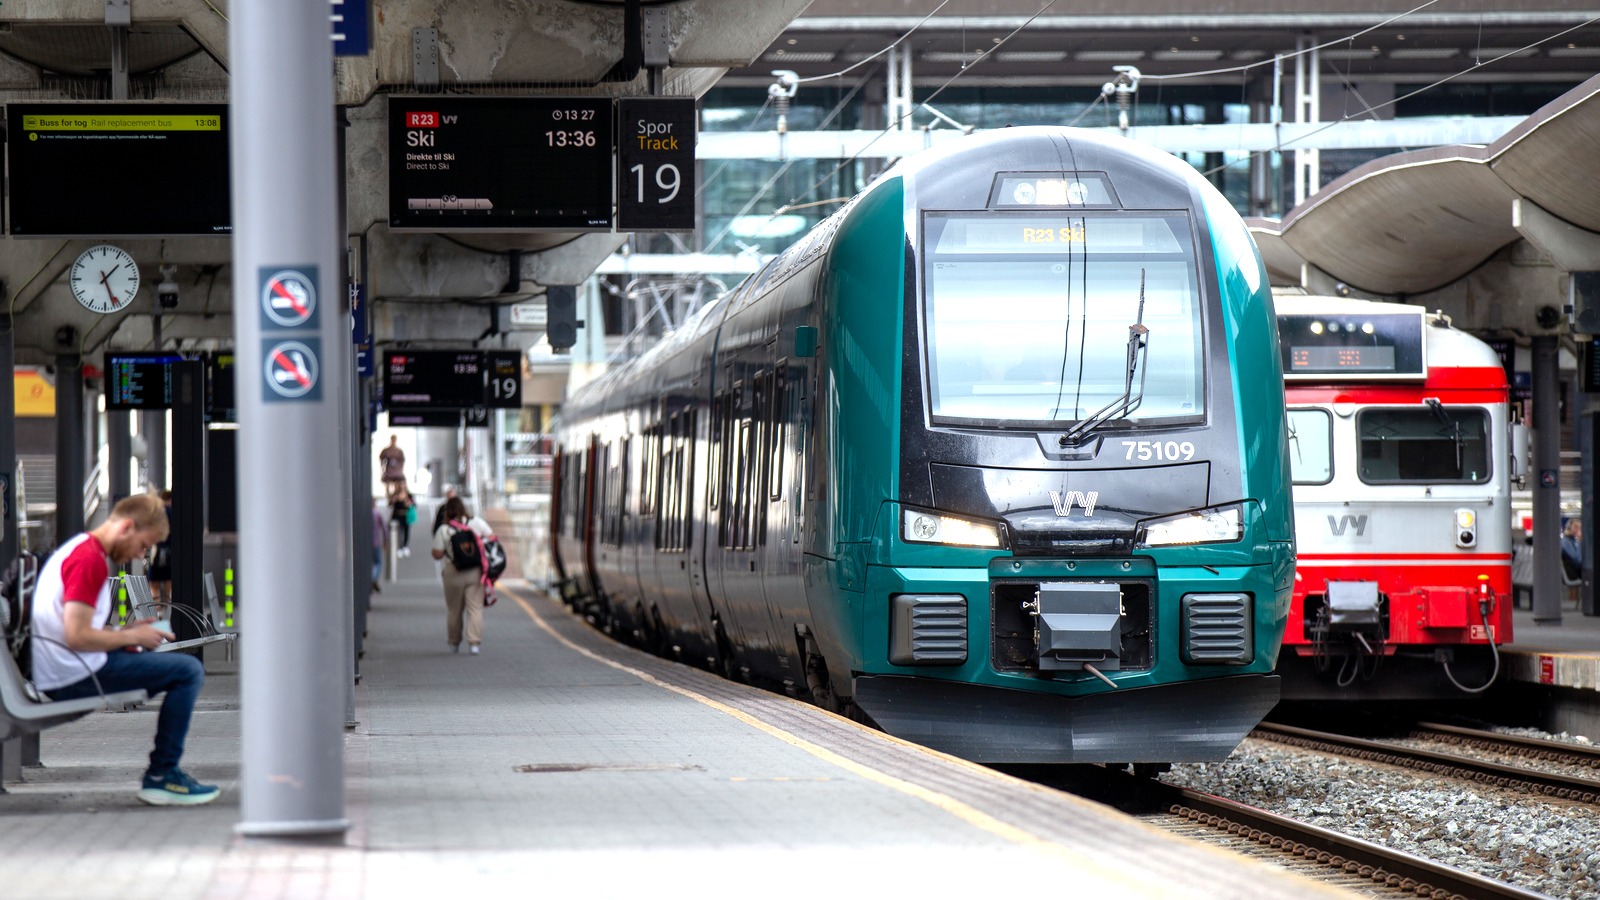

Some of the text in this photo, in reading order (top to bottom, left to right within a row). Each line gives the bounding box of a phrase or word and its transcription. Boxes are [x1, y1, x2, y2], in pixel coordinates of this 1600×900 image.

[40, 119, 217, 129] Buss for tog Rail replacement bus 13:08
[637, 119, 674, 138] Spor
[406, 130, 596, 147] Ski 13:36
[637, 135, 679, 151] Track
[406, 153, 455, 161] Direkte til Ski
[406, 162, 428, 170] Direct
[438, 162, 450, 170] Ski
[630, 163, 681, 204] 19
[1023, 227, 1085, 243] R23 Ski
[492, 377, 517, 399] 19
[1121, 441, 1195, 461] 75109
